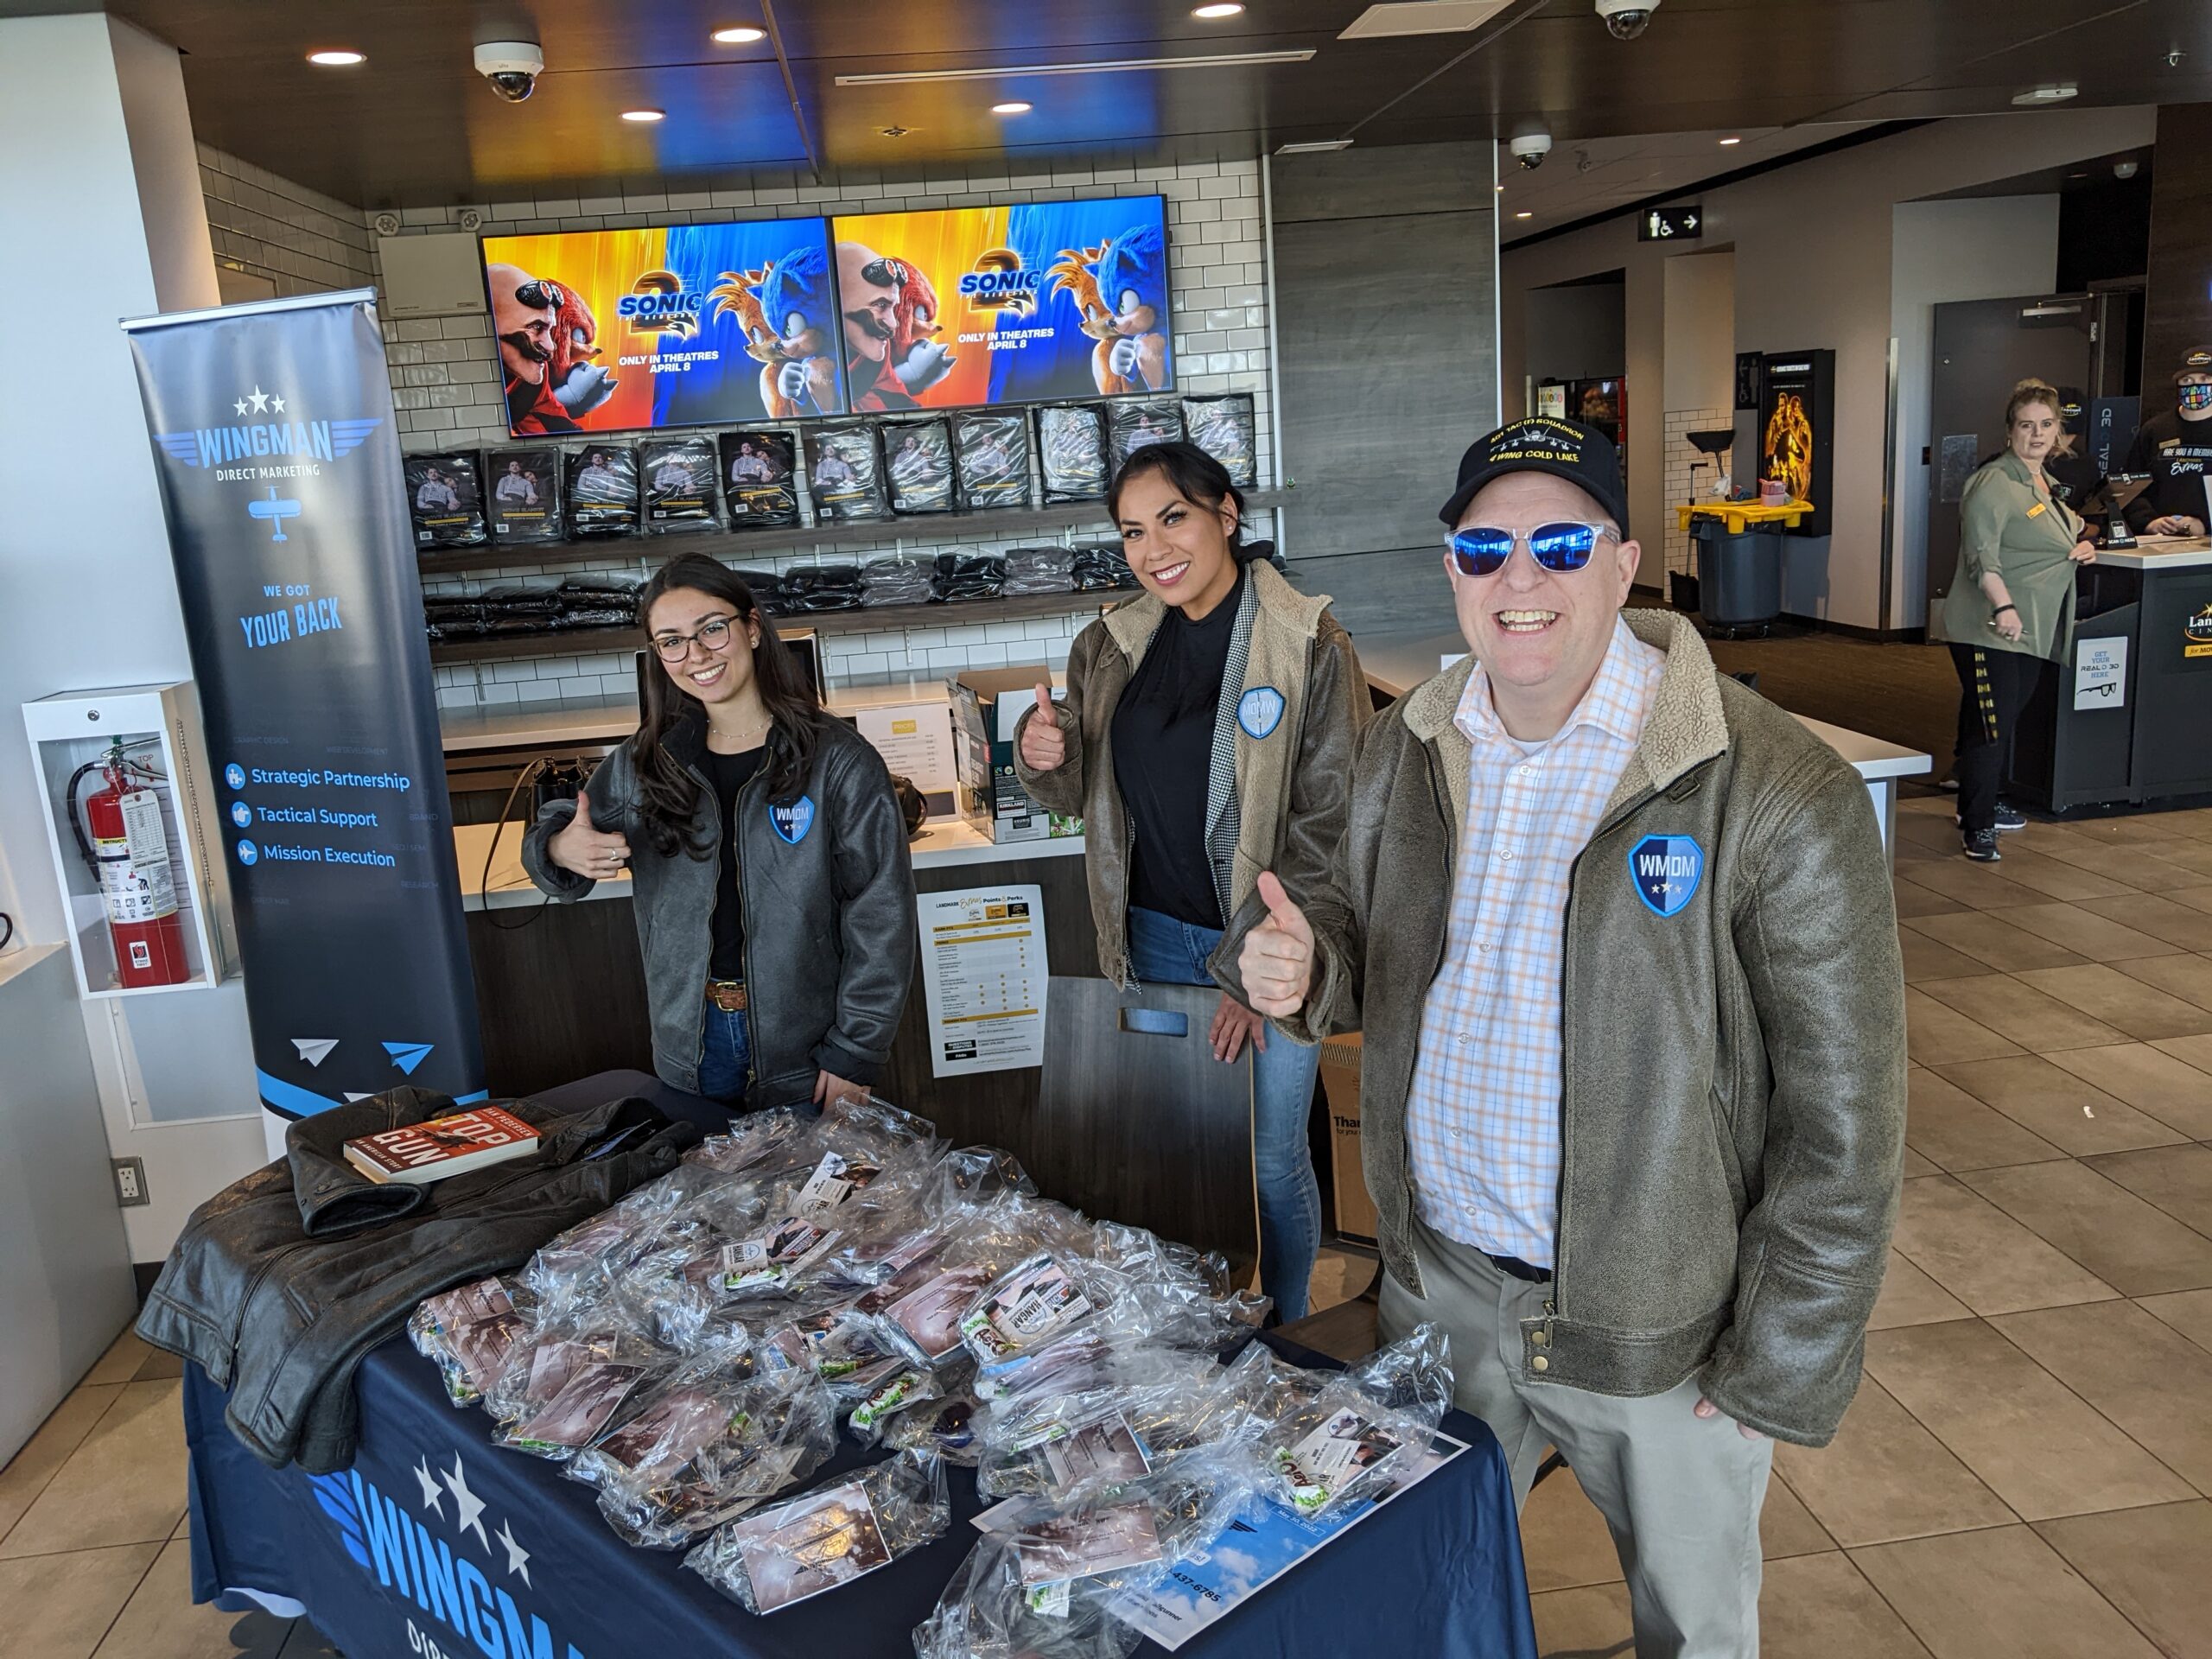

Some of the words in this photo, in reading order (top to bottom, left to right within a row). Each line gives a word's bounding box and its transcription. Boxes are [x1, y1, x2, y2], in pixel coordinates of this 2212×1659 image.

[960, 270, 1041, 293] SONIC
[619, 292, 702, 316] SONIC
[957, 333, 985, 343] ONLY
[987, 332, 998, 341] IN
[1000, 327, 1054, 340] THEATRES
[987, 341, 1018, 351] APRIL
[1019, 340, 1027, 348] 8
[619, 355, 647, 365] ONLY
[649, 354, 660, 364] IN
[663, 351, 719, 362] THEATRES
[649, 364, 681, 373] APRIL
[683, 362, 691, 372] 8
[1506, 422, 1522, 432] TAC
[1535, 418, 1585, 441] SQUADRON
[194, 420, 334, 469] WINGMAN
[2175, 448, 2186, 456] YOU
[1490, 454, 1497, 462] 4
[1497, 451, 1523, 460] WING
[1525, 450, 1553, 459] COLD
[1556, 452, 1580, 462] LAKE
[216, 467, 256, 481] DIRECT
[259, 464, 320, 480] MARKETING
[2171, 462, 2204, 475] Extras
[263, 585, 282, 597] WE
[286, 585, 311, 596] GOT
[240, 609, 291, 648] YOUR
[295, 596, 342, 637] BACK
[2189, 616, 2212, 627] Lan
[137, 753, 154, 762] TOP
[251, 768, 321, 787] Strategic
[324, 771, 410, 791] Partnership
[257, 807, 317, 824] Tactical
[320, 809, 378, 829] Support
[777, 807, 809, 821] WMDM
[264, 845, 321, 861] Mission
[325, 848, 396, 868] Execution
[1640, 855, 1694, 877] WMDM
[441, 1113, 512, 1145] TOP
[496, 1115, 535, 1138] PEDERSEN
[360, 1143, 386, 1160] AMERICAN
[385, 1156, 403, 1169] STORY
[372, 1128, 449, 1166] GUN
[1011, 1299, 1042, 1329] HANGAR
[1278, 1510, 1290, 1520] May
[1300, 1522, 1318, 1532] 2022
[351, 1469, 584, 1659] WINGM
[407, 1618, 450, 1659] DIR
